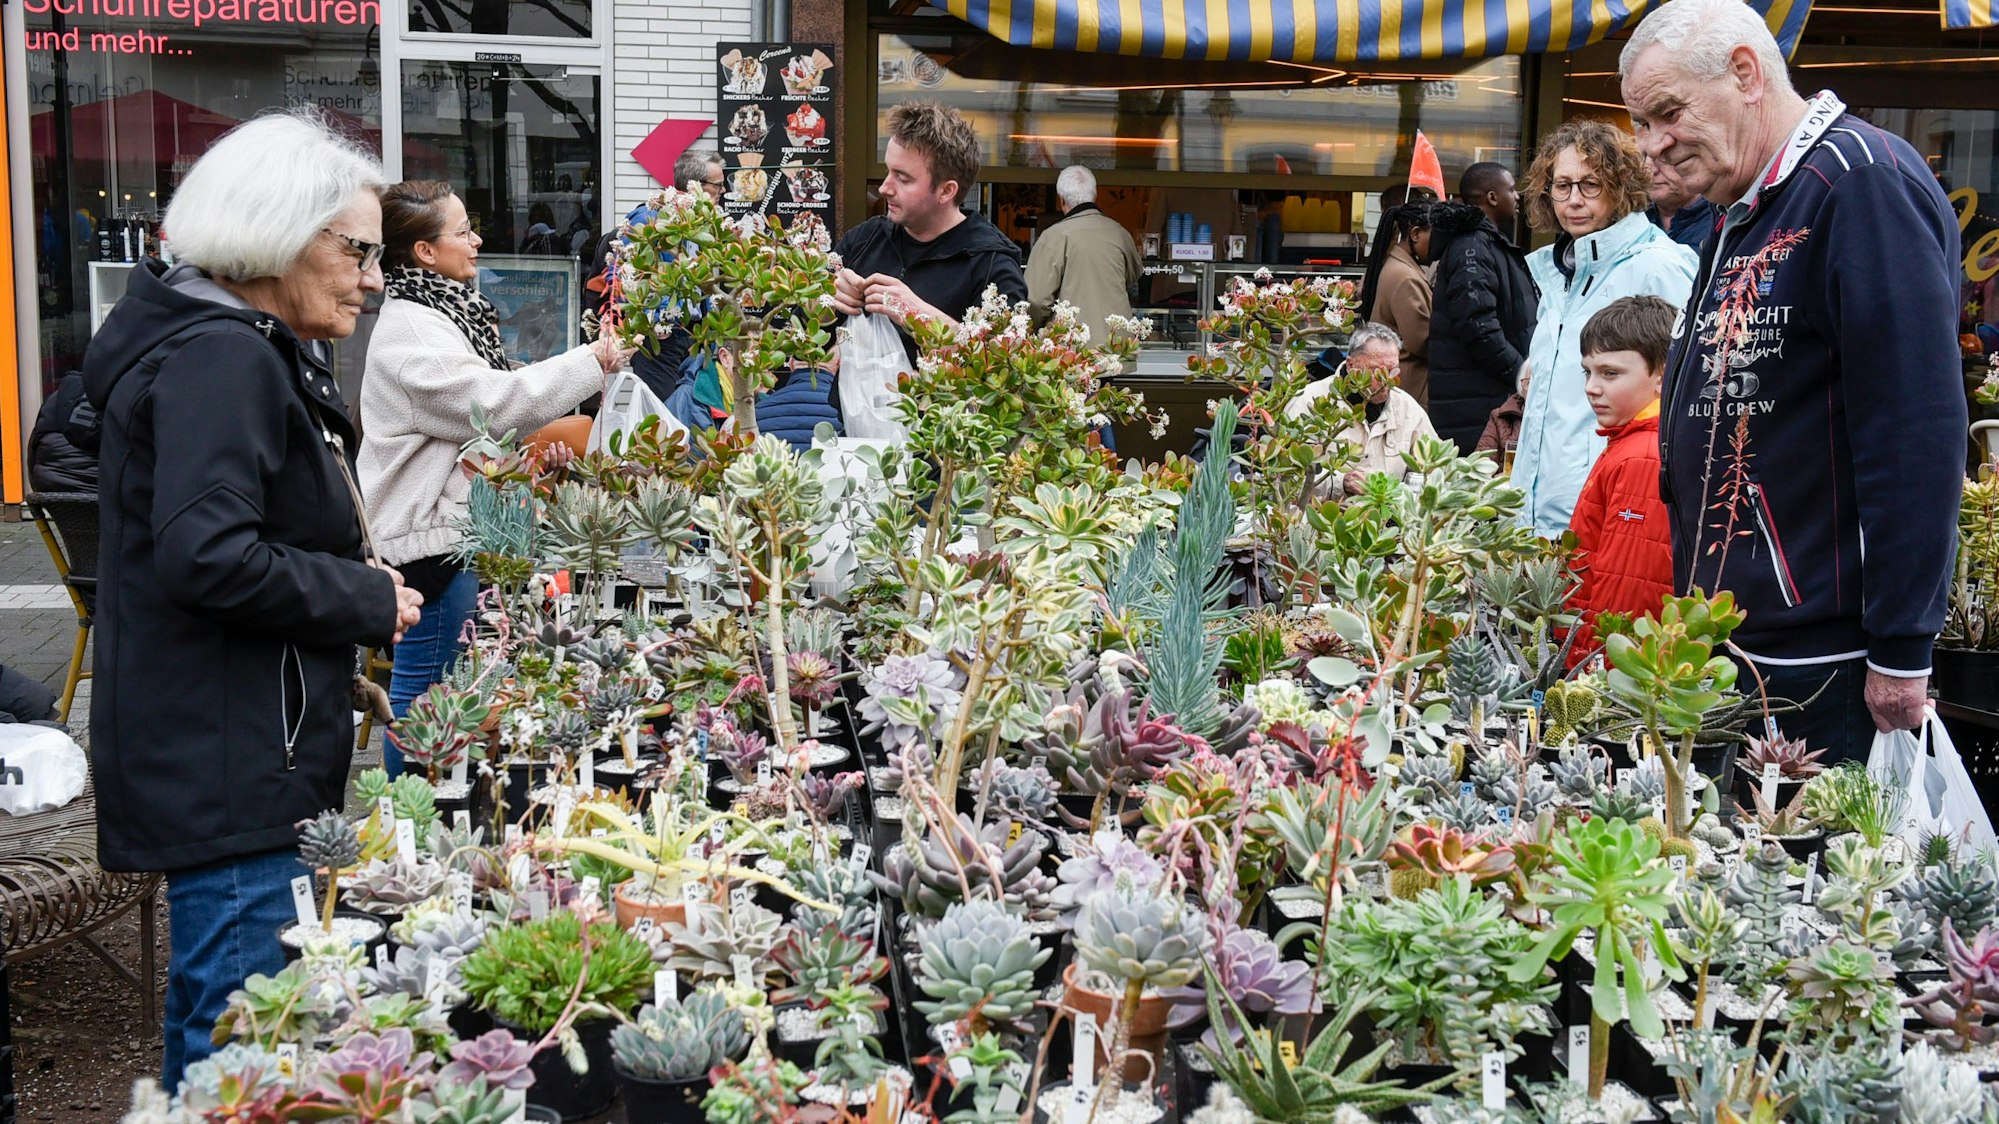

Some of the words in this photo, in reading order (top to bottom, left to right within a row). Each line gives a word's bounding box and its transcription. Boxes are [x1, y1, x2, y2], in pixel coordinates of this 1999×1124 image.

[25, 27, 80, 51] und
[91, 29, 193, 55] mehr...
[807, 93, 830, 101] Becher
[780, 150, 794, 167] Zum
[1726, 400, 1775, 416] CREW
